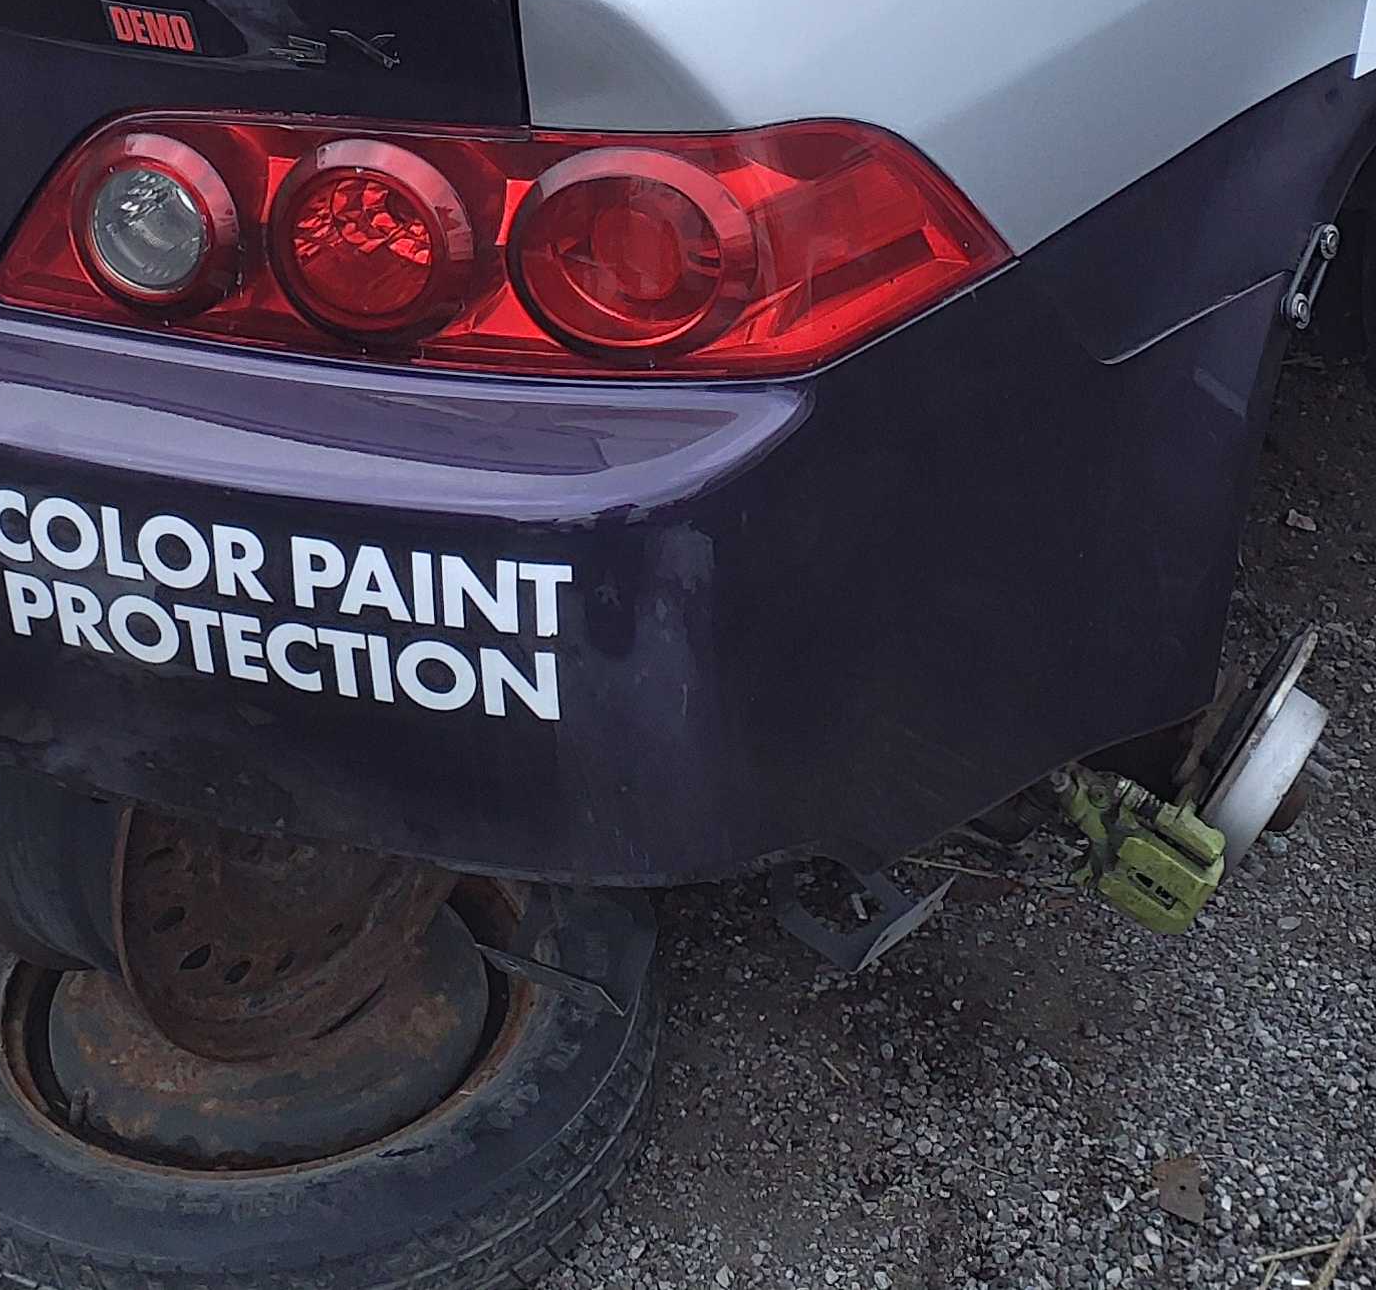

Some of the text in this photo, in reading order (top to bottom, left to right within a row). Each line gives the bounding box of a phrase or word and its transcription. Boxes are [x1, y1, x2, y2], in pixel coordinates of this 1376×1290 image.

[108, 6, 196, 53] DEMO
[290, 536, 573, 637] PAINT
[3, 569, 561, 721] PROTECTION
